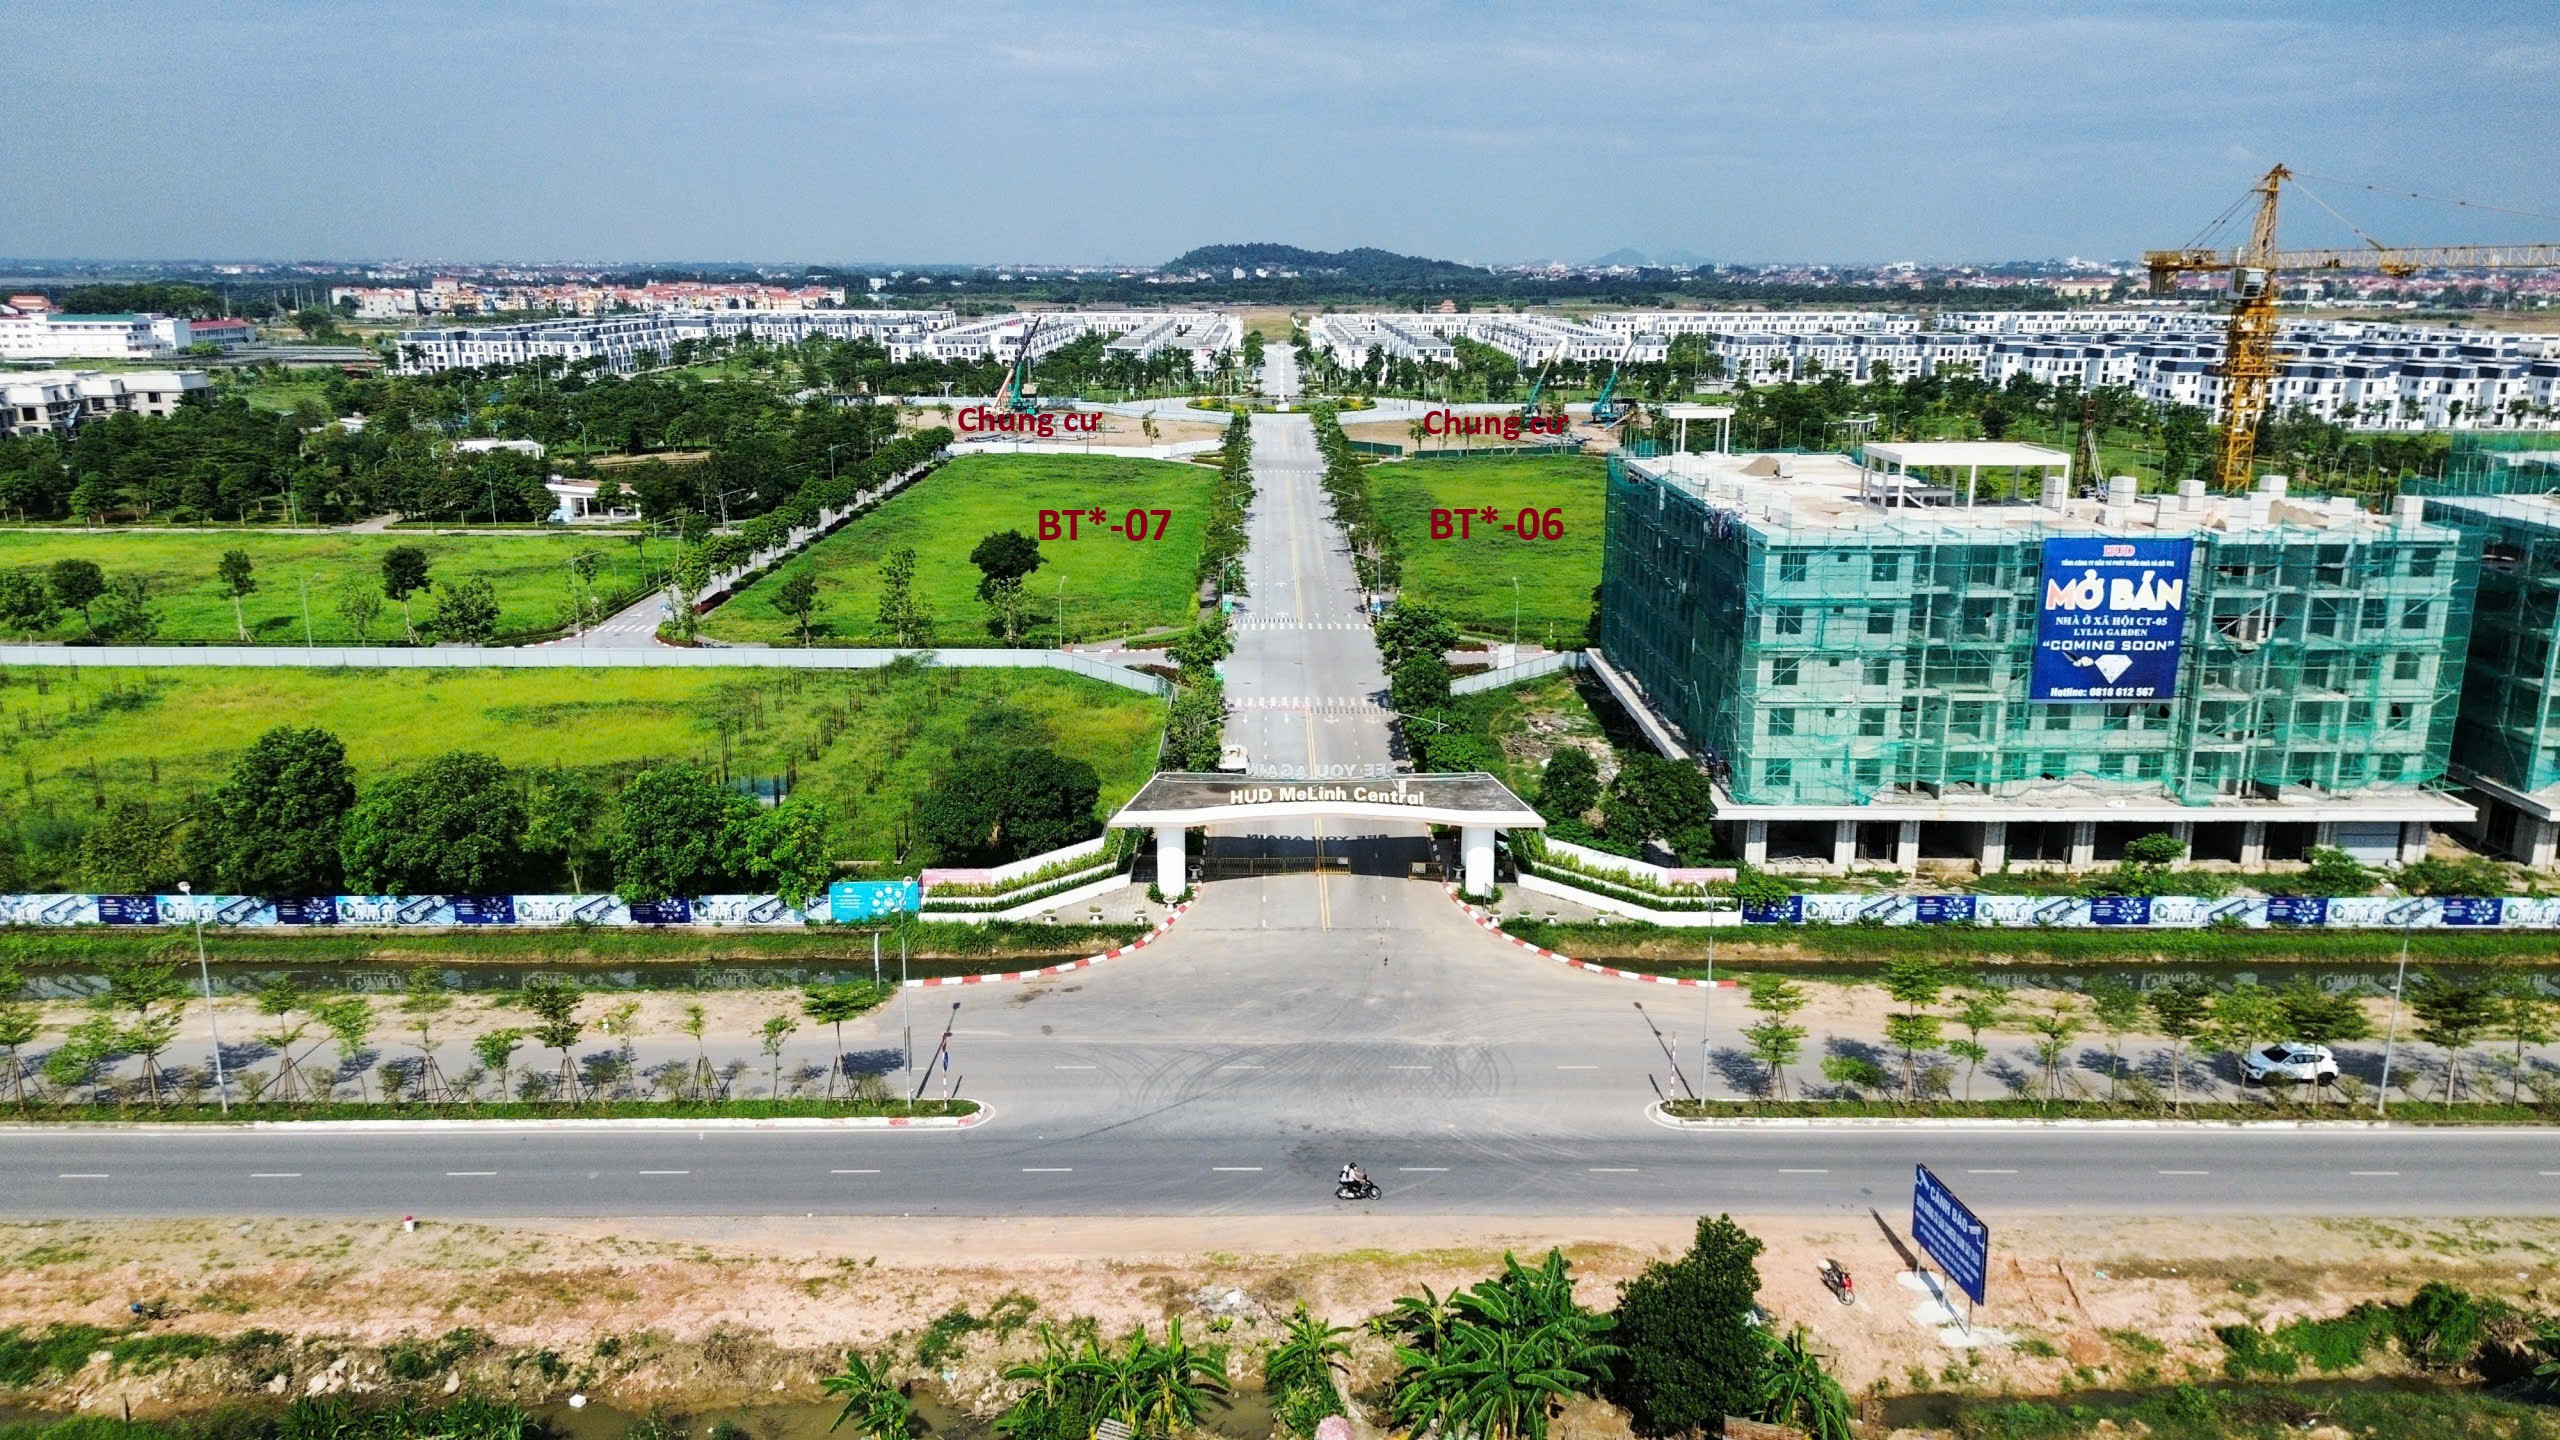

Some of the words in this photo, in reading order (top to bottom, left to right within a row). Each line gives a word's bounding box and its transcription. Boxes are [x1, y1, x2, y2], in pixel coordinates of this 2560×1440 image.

[2045, 569, 2105, 610] MỞ
[2109, 570, 2184, 611] BÁN
[2055, 614, 2080, 626] NHÀ
[2082, 614, 2092, 626] Ở
[2093, 615, 2110, 626] XÃ
[2112, 614, 2134, 628] HỘI
[2136, 616, 2168, 626] CT-05
[2073, 628, 2104, 637] LYLIA
[2106, 628, 2148, 637] GARDEN
[2050, 687, 2088, 698] Hotline:
[2115, 687, 2135, 697] 612
[2136, 687, 2155, 697] 567
[1230, 788, 1273, 805] HUD
[1279, 786, 1347, 802] MeLinh
[1353, 786, 1425, 806] Central
[1951, 1207, 1968, 1233] BÁO
